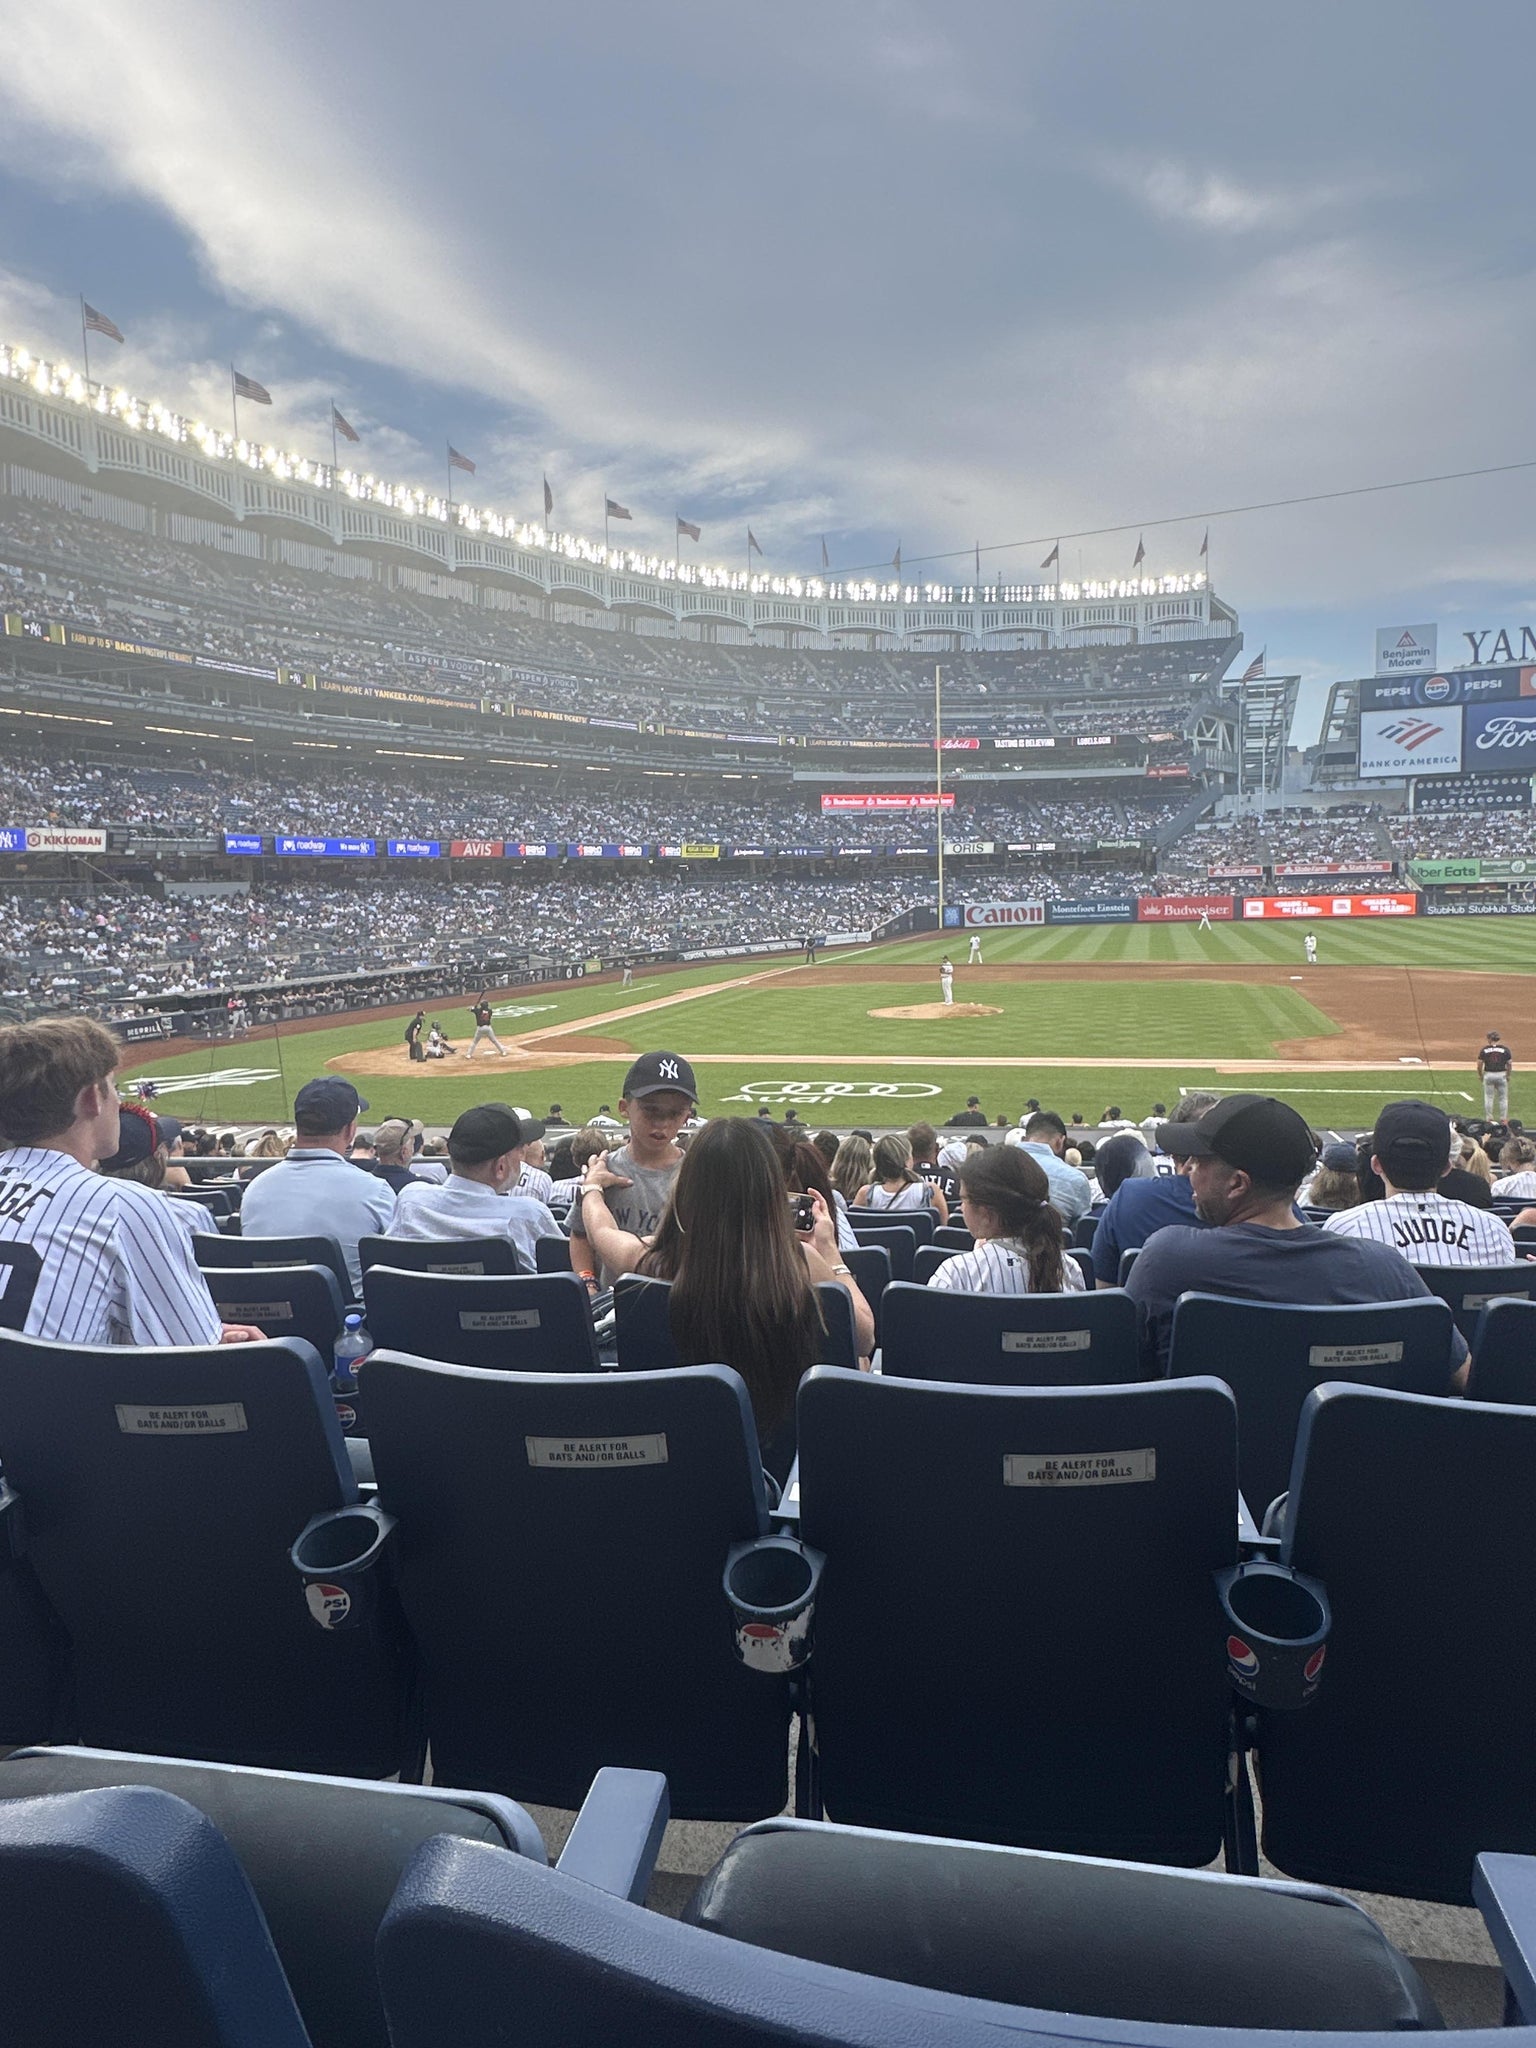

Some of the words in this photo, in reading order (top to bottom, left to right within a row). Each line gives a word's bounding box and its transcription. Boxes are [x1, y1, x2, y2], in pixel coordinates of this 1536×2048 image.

[88, 636, 96, 646] UP
[115, 641, 136, 654] BACK
[1382, 647, 1430, 660] Benjamin
[408, 653, 439, 667] ASPEN
[450, 660, 480, 673] VODKA
[1388, 658, 1422, 668] Moore
[515, 672, 543, 683] ASPEN
[550, 678, 576, 689] VODKA
[1464, 680, 1502, 691] PEPSI
[320, 681, 342, 692] LEARN
[342, 684, 363, 696] MORE
[364, 688, 373, 697] AT
[1375, 686, 1411, 697] PEPSI
[1362, 760, 1390, 769] BANK
[1393, 758, 1407, 767] OF
[1408, 756, 1458, 766] AMERICA
[44, 835, 102, 846] KIKKOMAN
[297, 840, 327, 852] roadway
[1096, 840, 1118, 849] Poland
[1119, 839, 1141, 849] Spring
[463, 843, 492, 856] AVIS
[952, 843, 984, 854] ORIS
[1445, 867, 1476, 877] Eats
[1052, 903, 1096, 914] Montefiore
[1097, 902, 1130, 912] Einstein
[1164, 904, 1230, 916] Budweiser
[1427, 906, 1465, 915] StubHub
[1468, 905, 1508, 914] StubHub
[966, 905, 1043, 924] Canon
[658, 1058, 679, 1079] NY
[719, 1094, 836, 1104] Audi
[0, 1181, 56, 1224] GE
[639, 1210, 660, 1232] YO
[1393, 1218, 1475, 1251] JUDGE
[149, 1411, 161, 1420] BE
[162, 1411, 189, 1420] ALERT
[191, 1410, 208, 1419] FOR
[137, 1420, 159, 1429] BATS
[198, 1419, 226, 1427] BALLS
[564, 1443, 576, 1452] BE
[578, 1443, 607, 1452] ALERT
[610, 1442, 628, 1451] FOR
[549, 1452, 573, 1462] BATS
[575, 1452, 614, 1462] AND/OR
[616, 1450, 646, 1460] BALLS
[1045, 1461, 1058, 1470] BE
[1061, 1460, 1093, 1470] ALERT
[1095, 1458, 1115, 1468] FOR
[1027, 1470, 1053, 1480] BATS
[1056, 1469, 1098, 1480] AND/OR
[1101, 1467, 1133, 1478] BALLS
[324, 1597, 347, 1610] PSI
